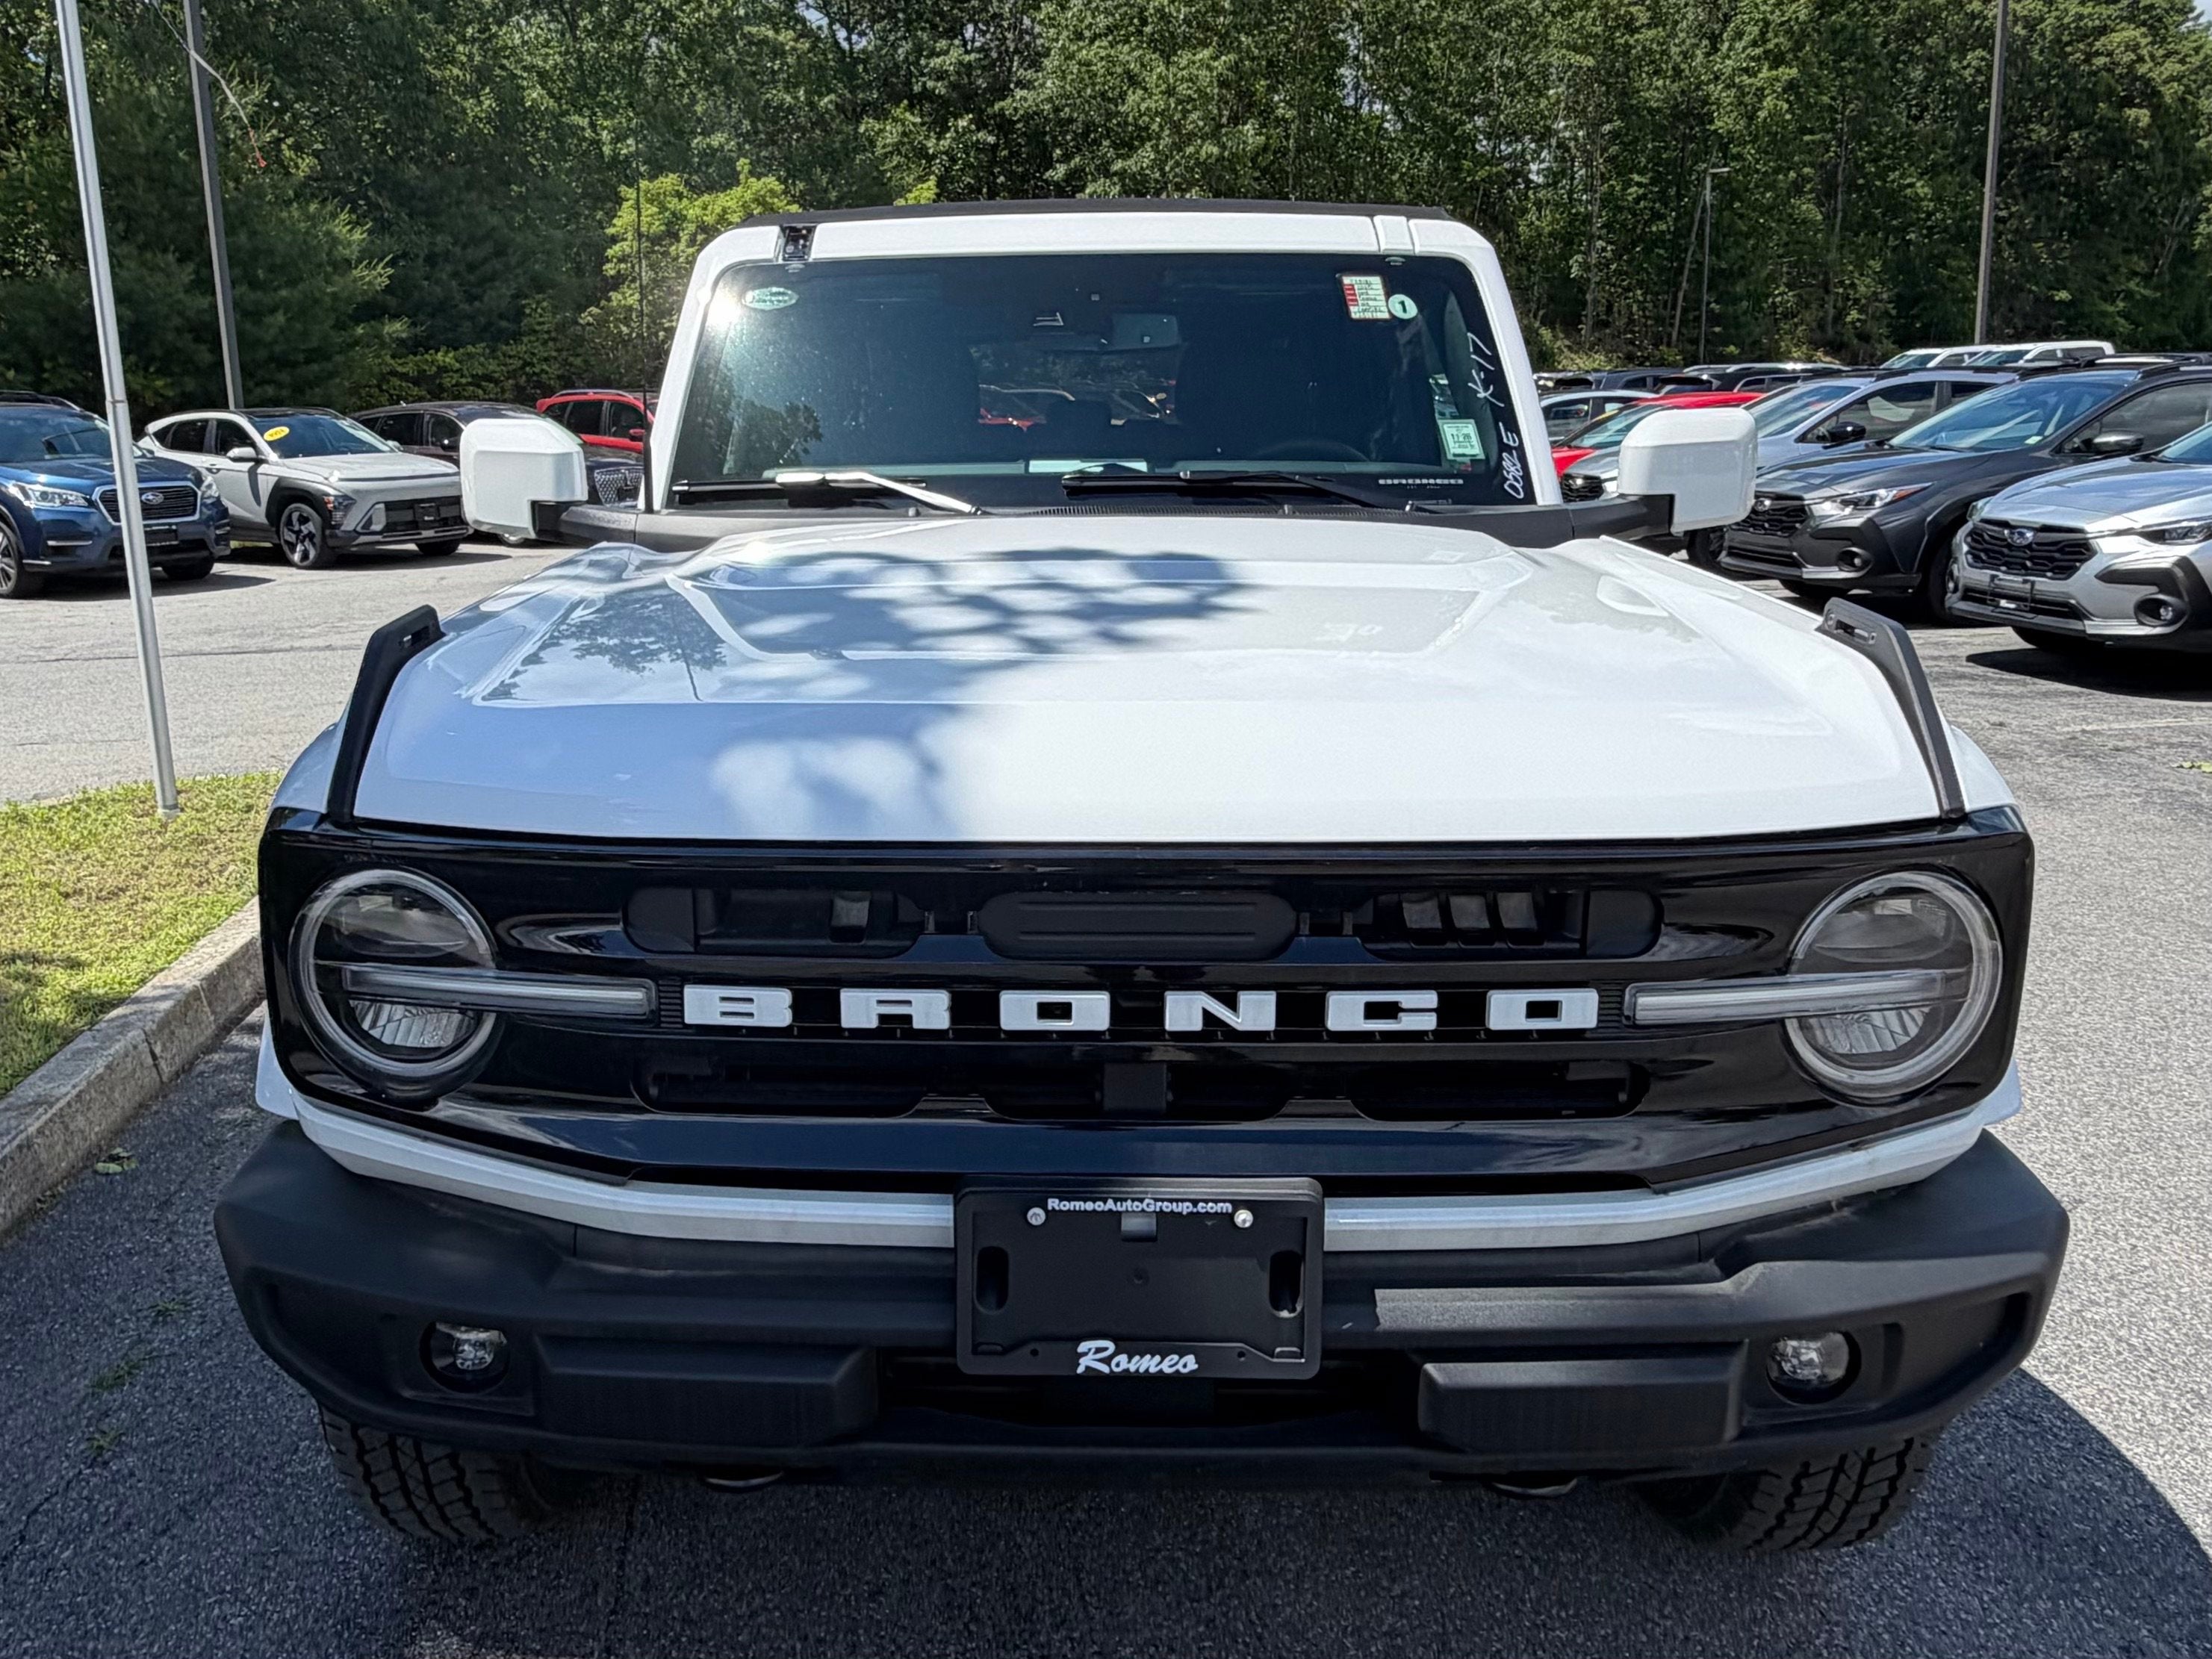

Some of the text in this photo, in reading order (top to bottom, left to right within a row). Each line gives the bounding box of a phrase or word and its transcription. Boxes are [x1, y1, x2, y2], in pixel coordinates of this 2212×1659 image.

[1398, 300, 1407, 314] 1
[1467, 332, 1506, 408] K-17
[683, 983, 1599, 1031] BRONCO
[1047, 1197, 1231, 1215] RomeoAutoGroup.com
[1076, 1339, 1199, 1375] Romeo
